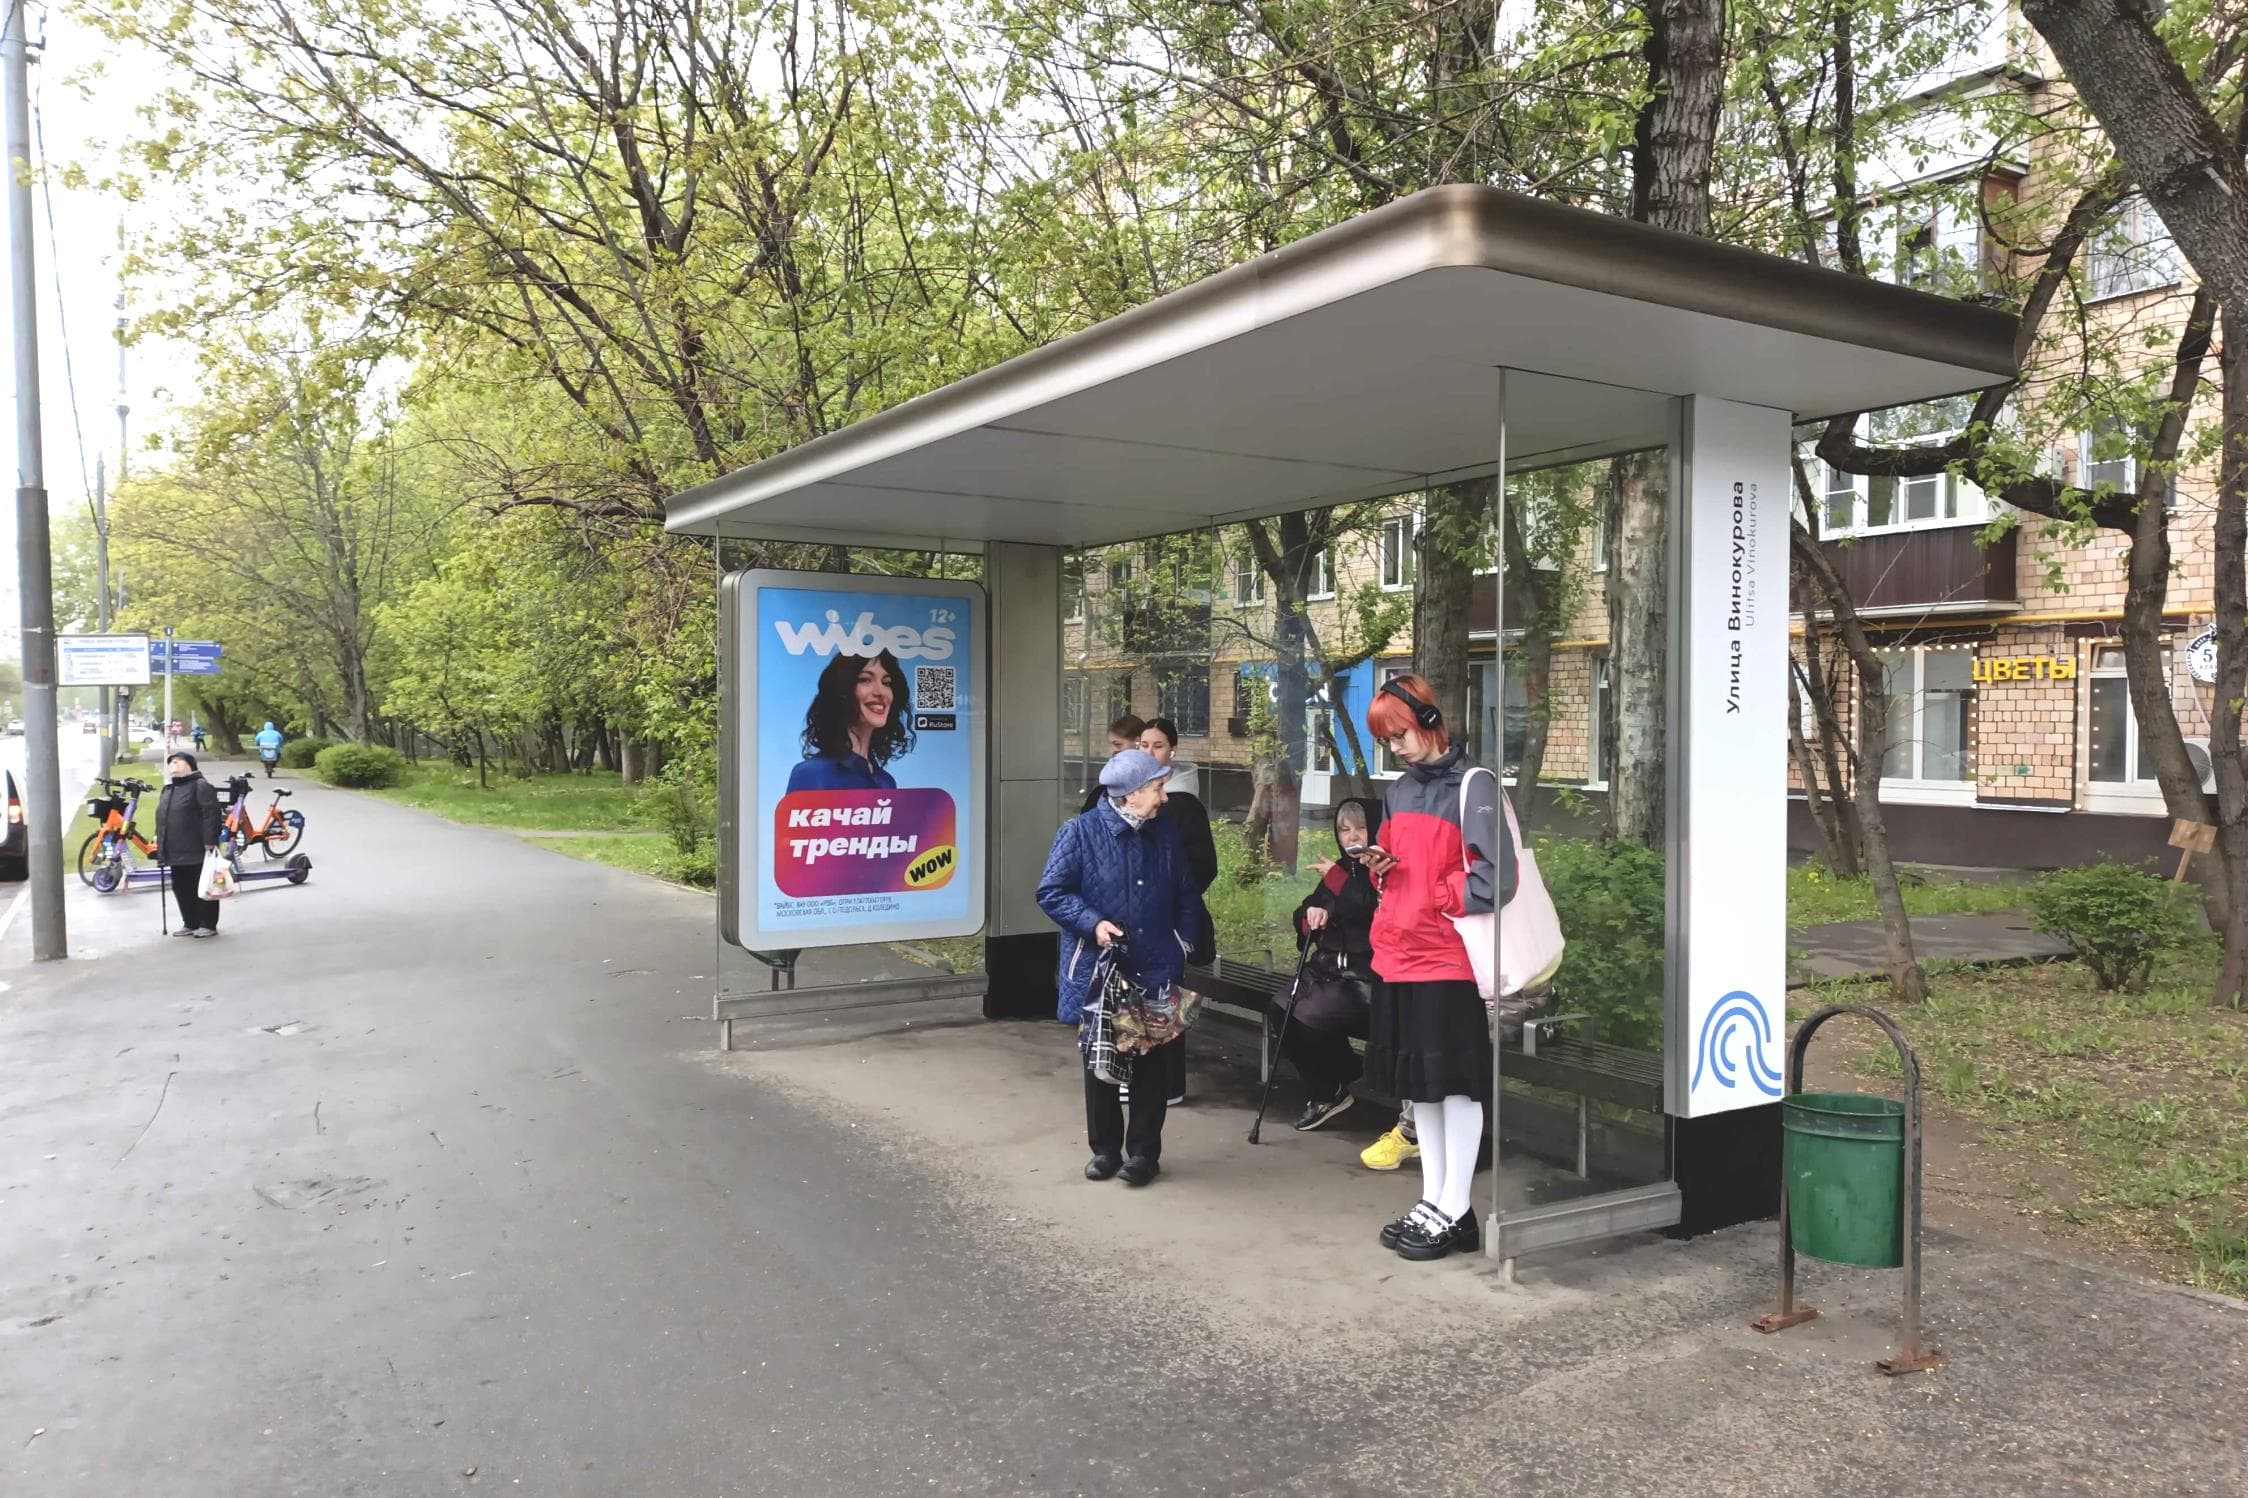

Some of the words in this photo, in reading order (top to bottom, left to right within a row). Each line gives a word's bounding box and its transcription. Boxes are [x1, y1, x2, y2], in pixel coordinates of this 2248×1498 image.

[1747, 483, 1757, 574] Vinokurova
[1728, 481, 1745, 630] Винокурова
[930, 609, 956, 623] 12+
[1745, 580, 1755, 626] Ulitsa
[774, 609, 956, 660] wibes
[1727, 640, 1742, 713] Улица
[1973, 656, 2077, 684] ЦВЕТЫ
[788, 798, 892, 828] качай
[789, 835, 918, 865] тренды
